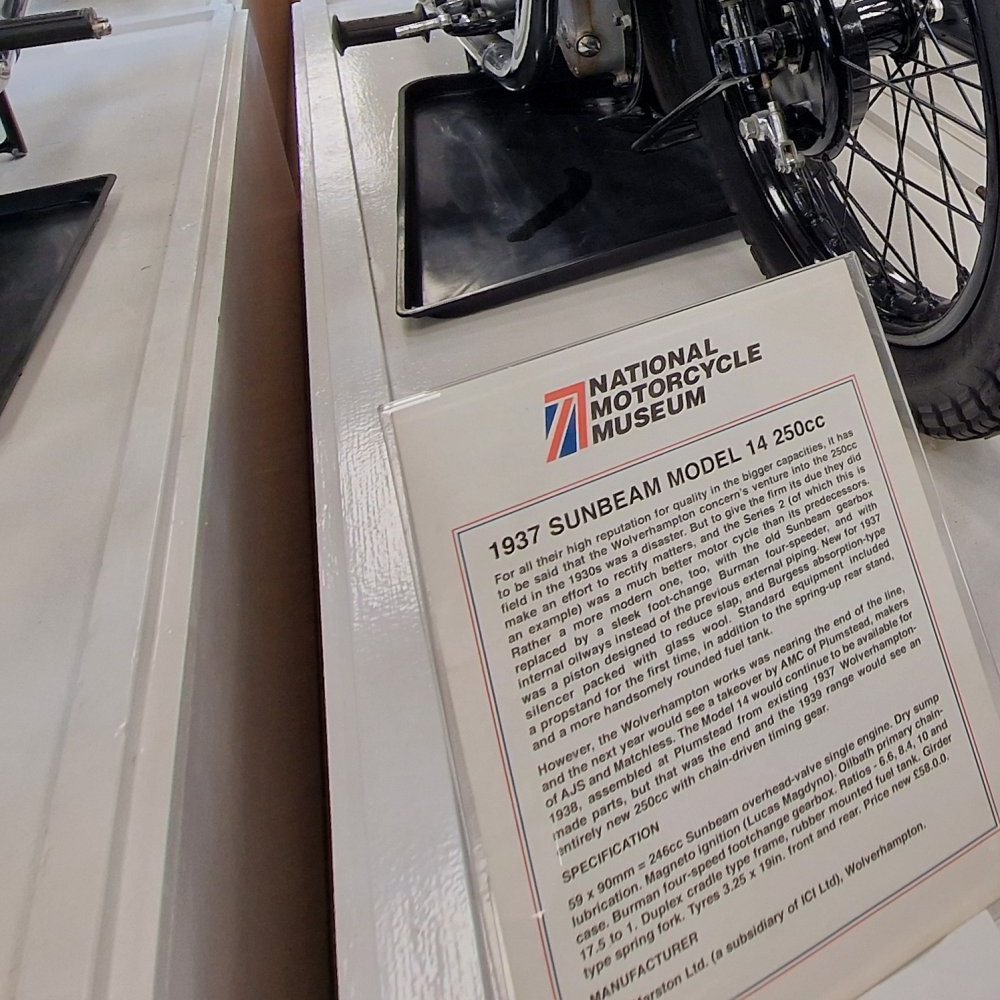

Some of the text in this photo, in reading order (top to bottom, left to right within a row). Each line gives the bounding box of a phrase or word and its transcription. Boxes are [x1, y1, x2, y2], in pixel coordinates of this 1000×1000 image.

[589, 338, 718, 397] NATIONAL
[590, 343, 763, 420] MOTORCYCLE
[592, 386, 707, 444] MUSEUM
[488, 414, 826, 560] 1937 SUNBEAM MODEL 14 250cc
[493, 429, 854, 585] For all their high reputation for quality in the bigger capacities, it has
[497, 588, 511, 600] to
[513, 579, 530, 593] be
[533, 565, 560, 585] said
[562, 554, 586, 572] that
[588, 547, 608, 561] the
[610, 510, 696, 552] Wolverhampton
[751, 470, 789, 492] venture
[790, 461, 811, 475] into
[812, 454, 829, 466] the
[830, 441, 858, 459] 250cc
[500, 451, 862, 615] field in the 1930s was a disaster. But to give the firm its due they did
[504, 465, 866, 630] make an effort to rectify matters, and the Series 2 (of which this is
[514, 501, 878, 675] replaced by a sleek foot-change Burman four-speeder, and with
[537, 586, 906, 777] However, the Wolverhampton works was nearing the end of the line,
[561, 820, 660, 884] SPECIFICATION
[567, 893, 584, 911] 59
[586, 889, 595, 902] x
[596, 866, 636, 895] 90mm
[648, 839, 684, 866] 246cc
[685, 807, 740, 844] Sunbeam
[741, 760, 823, 813] overhead-valve
[823, 741, 856, 766] single
[856, 721, 893, 747] engine.
[893, 709, 911, 726] Dry
[912, 693, 940, 715] sump
[589, 931, 699, 1000] MANUFACTURER
[634, 822, 927, 1000] arston Ltd. (a subsidiary of ICI Ltd), Wolverhampton.
